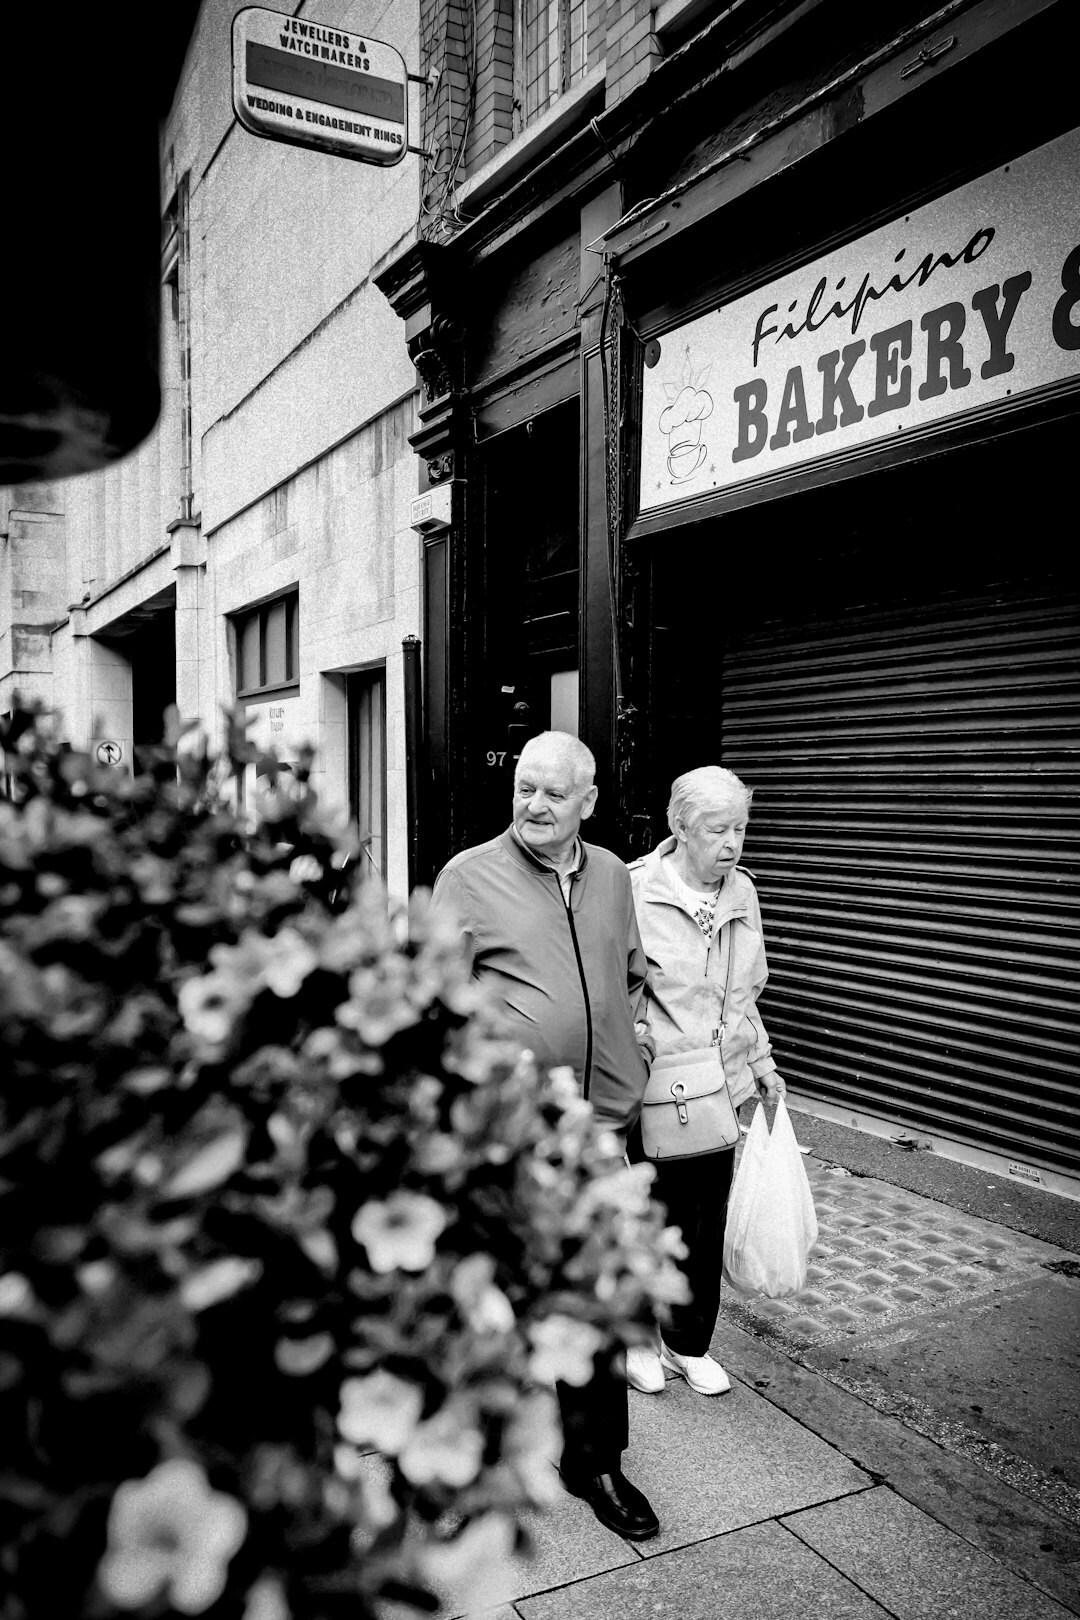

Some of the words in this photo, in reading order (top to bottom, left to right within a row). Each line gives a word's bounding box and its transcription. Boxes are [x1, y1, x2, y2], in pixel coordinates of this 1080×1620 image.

[280, 33, 370, 71] WATCHMAKERS
[284, 19, 350, 49] JEWELLERS
[358, 40, 367, 53] &
[246, 94, 293, 118] WEDDING
[295, 108, 304, 120] &
[305, 110, 372, 137] ENGAGEMENT
[373, 127, 403, 145] RINGS
[751, 227, 996, 367] Filipino
[731, 270, 1032, 464] BAKERY
[486, 750, 507, 767] 97
